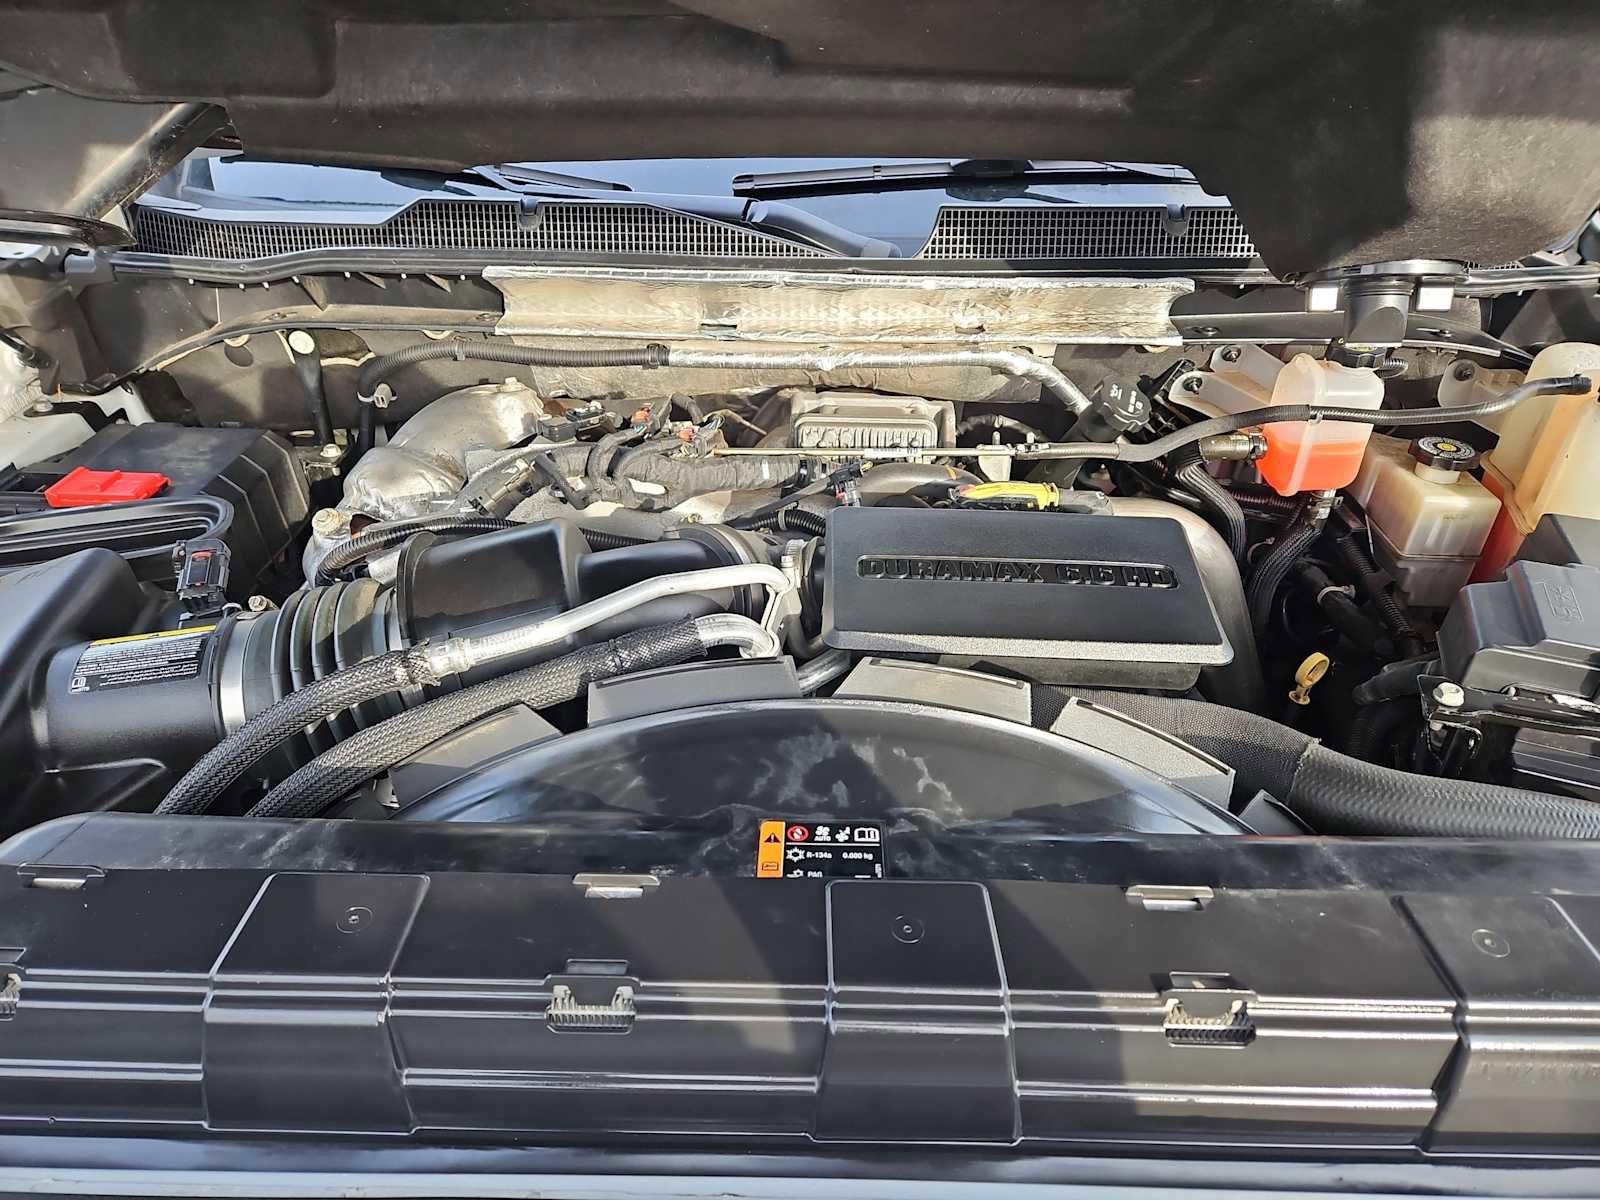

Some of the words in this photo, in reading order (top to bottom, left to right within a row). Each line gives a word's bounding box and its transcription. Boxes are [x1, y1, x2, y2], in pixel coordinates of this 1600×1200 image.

[863, 558, 1044, 582] DURAMAX
[806, 851, 832, 859] R-134a
[864, 852, 873, 860] kg
